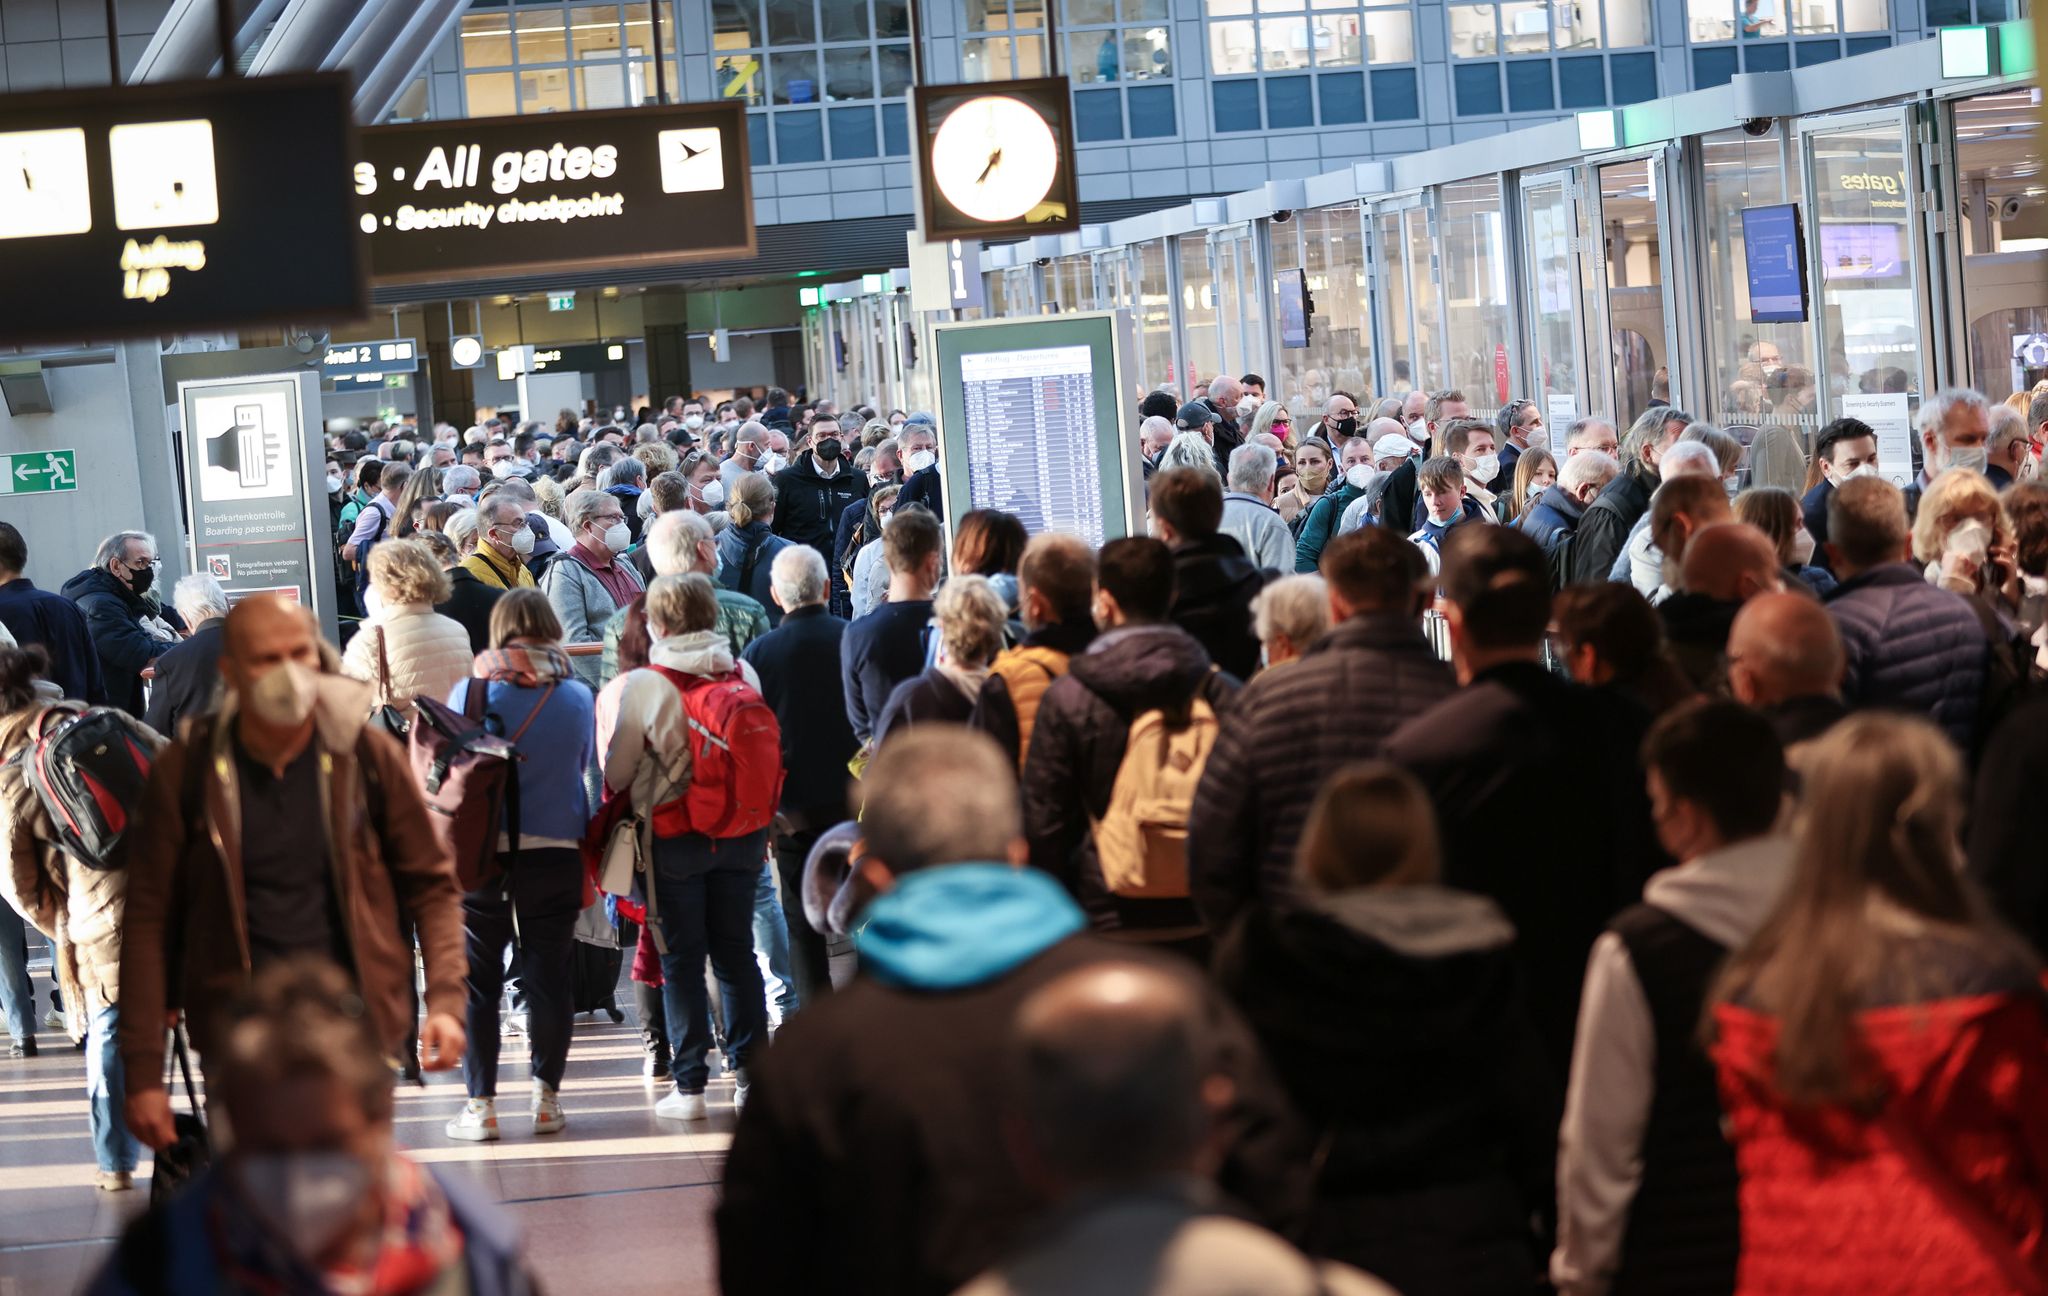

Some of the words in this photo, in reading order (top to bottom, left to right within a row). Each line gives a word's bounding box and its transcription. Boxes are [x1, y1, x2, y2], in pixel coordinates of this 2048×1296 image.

[414, 143, 481, 191] All
[492, 142, 618, 194] gates
[396, 201, 495, 231] Security
[497, 191, 625, 224] checkpoint
[205, 511, 286, 523] Bordkartenkontrolle
[206, 527, 243, 536] Boarding
[245, 526, 265, 535] pass
[267, 523, 296, 532] control
[236, 561, 273, 569] Fotografieren
[274, 559, 299, 567] verboten
